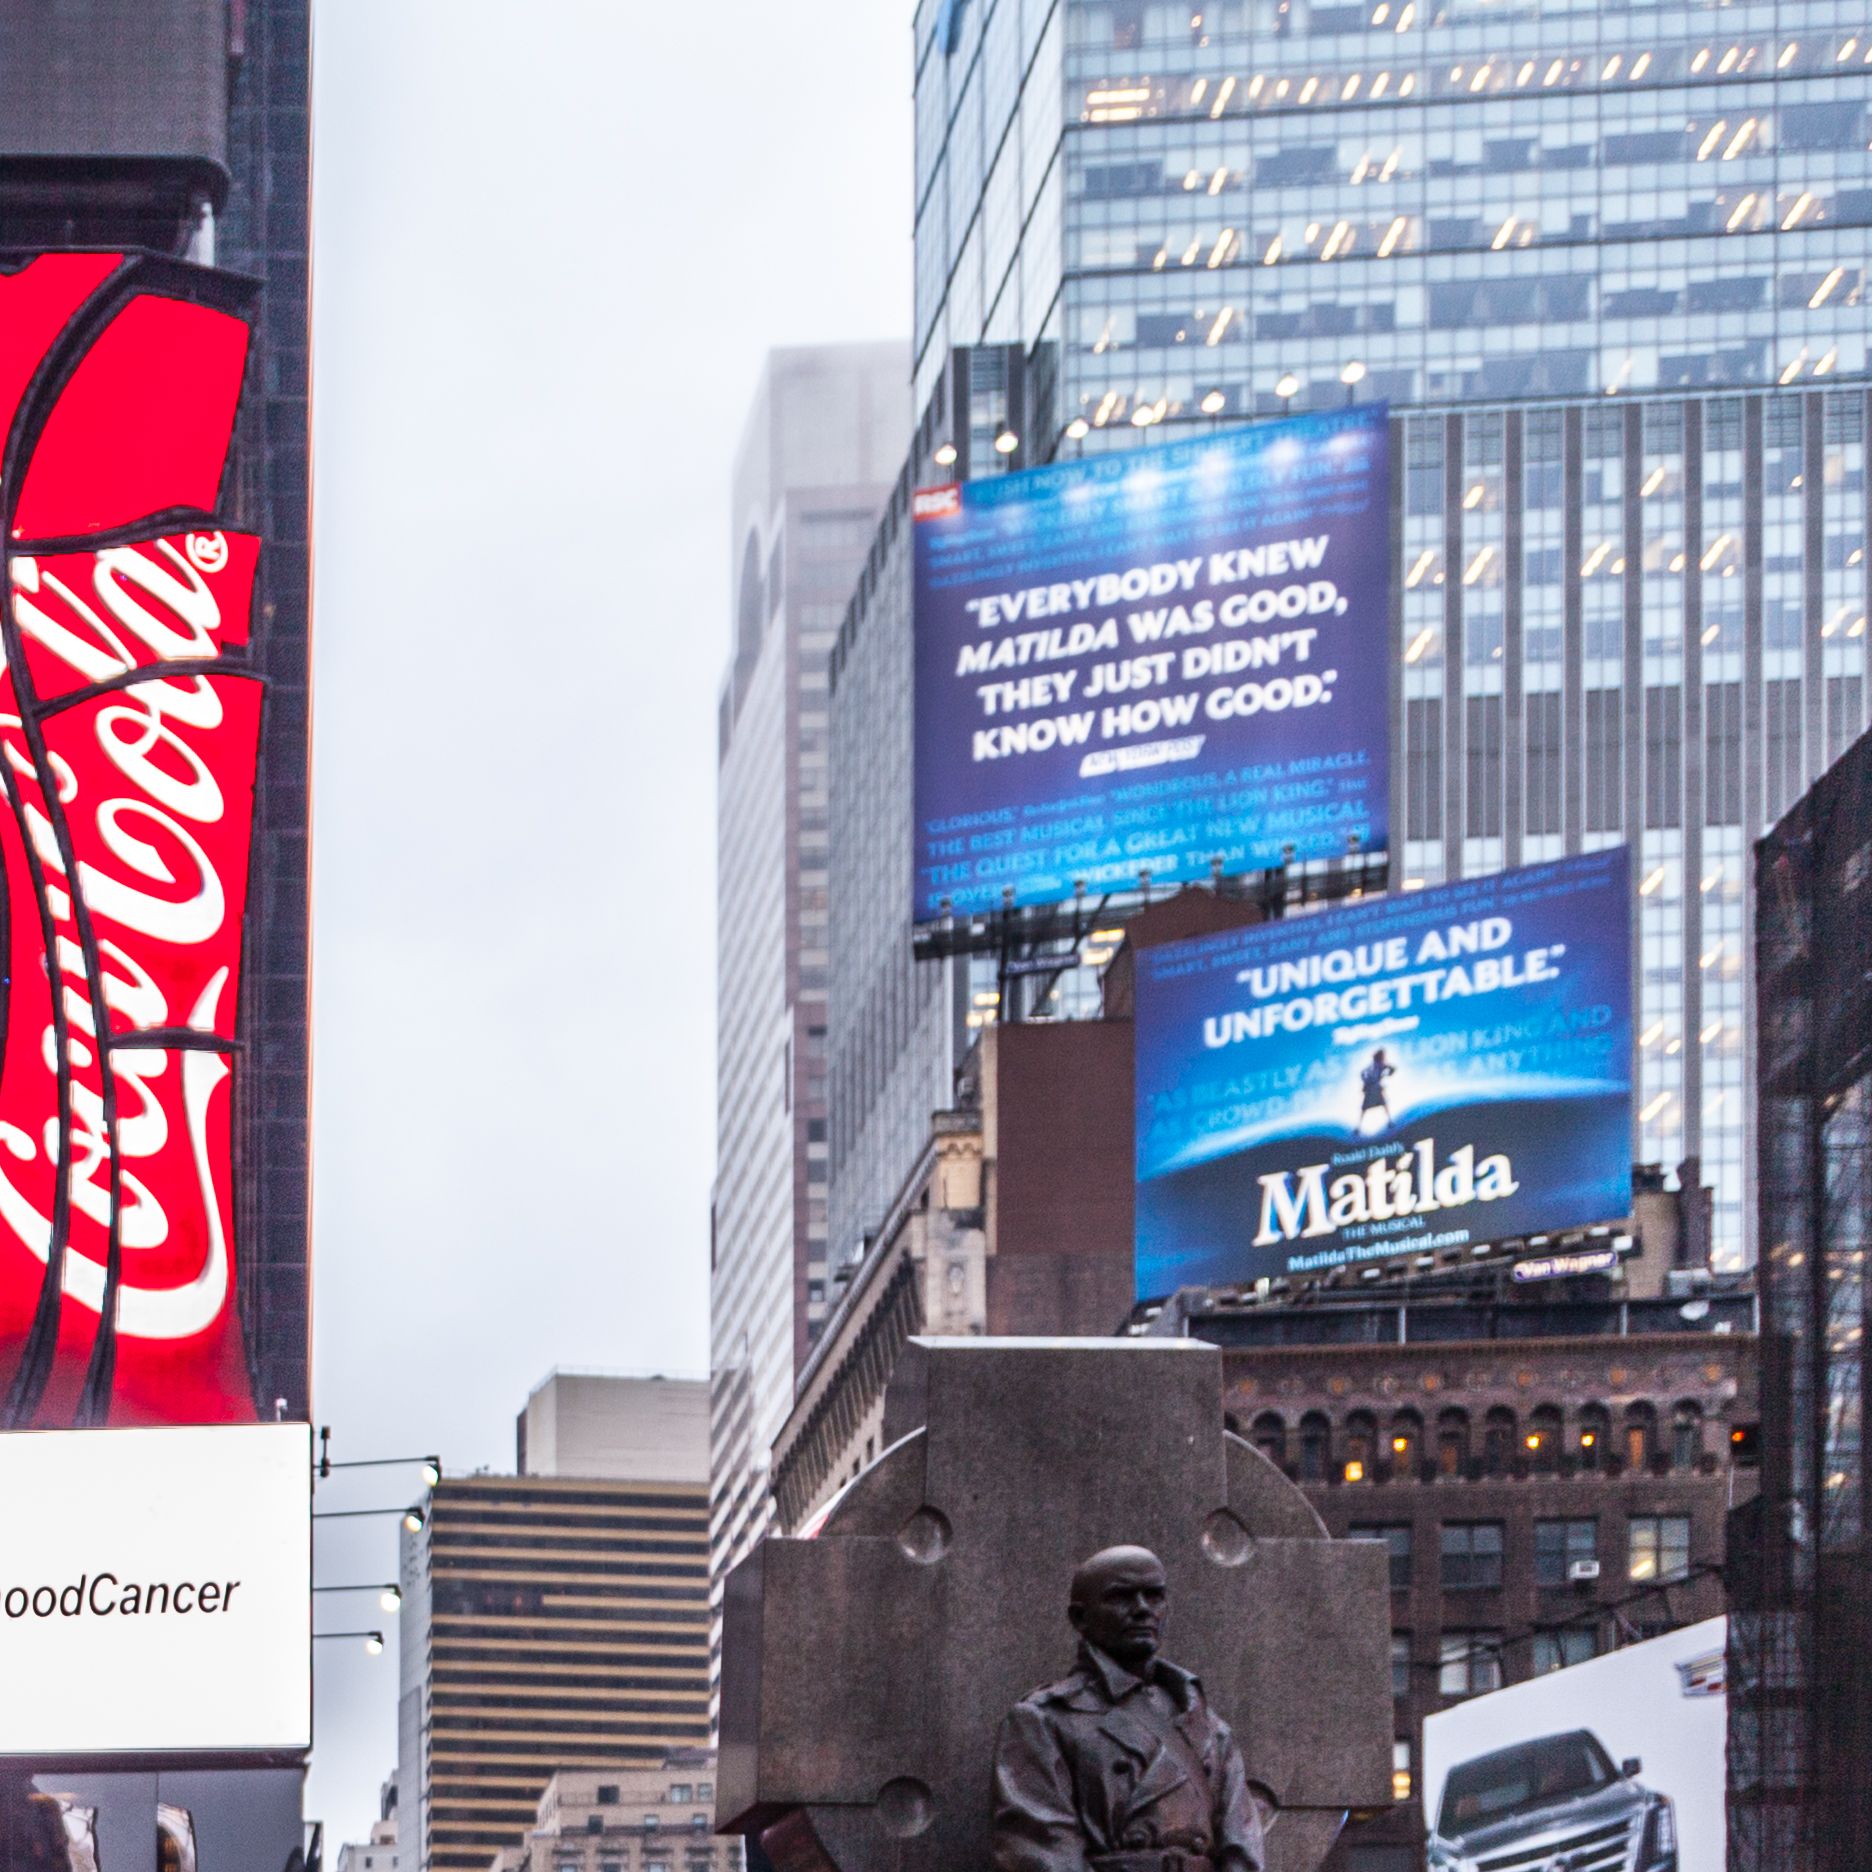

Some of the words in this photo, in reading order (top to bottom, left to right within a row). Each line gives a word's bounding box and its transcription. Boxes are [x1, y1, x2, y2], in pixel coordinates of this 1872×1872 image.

[965, 556, 1203, 630] "EVERYBODY
[1208, 534, 1330, 586] KNEW
[956, 616, 1119, 677] MATILDA
[1128, 603, 1216, 645] WAS
[1220, 579, 1349, 632] GOOD,
[978, 668, 1073, 717] THEY
[1082, 654, 1173, 700] JUST
[1182, 627, 1318, 681] DIDN'T
[971, 711, 1094, 763] KNOW
[1100, 699, 1198, 742] HOW
[1237, 936, 1408, 999] "UNIQUE
[1415, 916, 1512, 963] AND
[1252, 1137, 1520, 1248] Matilda
[1369, 1215, 1427, 1237] MUSICAL
[1287, 1229, 1471, 1273] MatildaTheMusical.com
